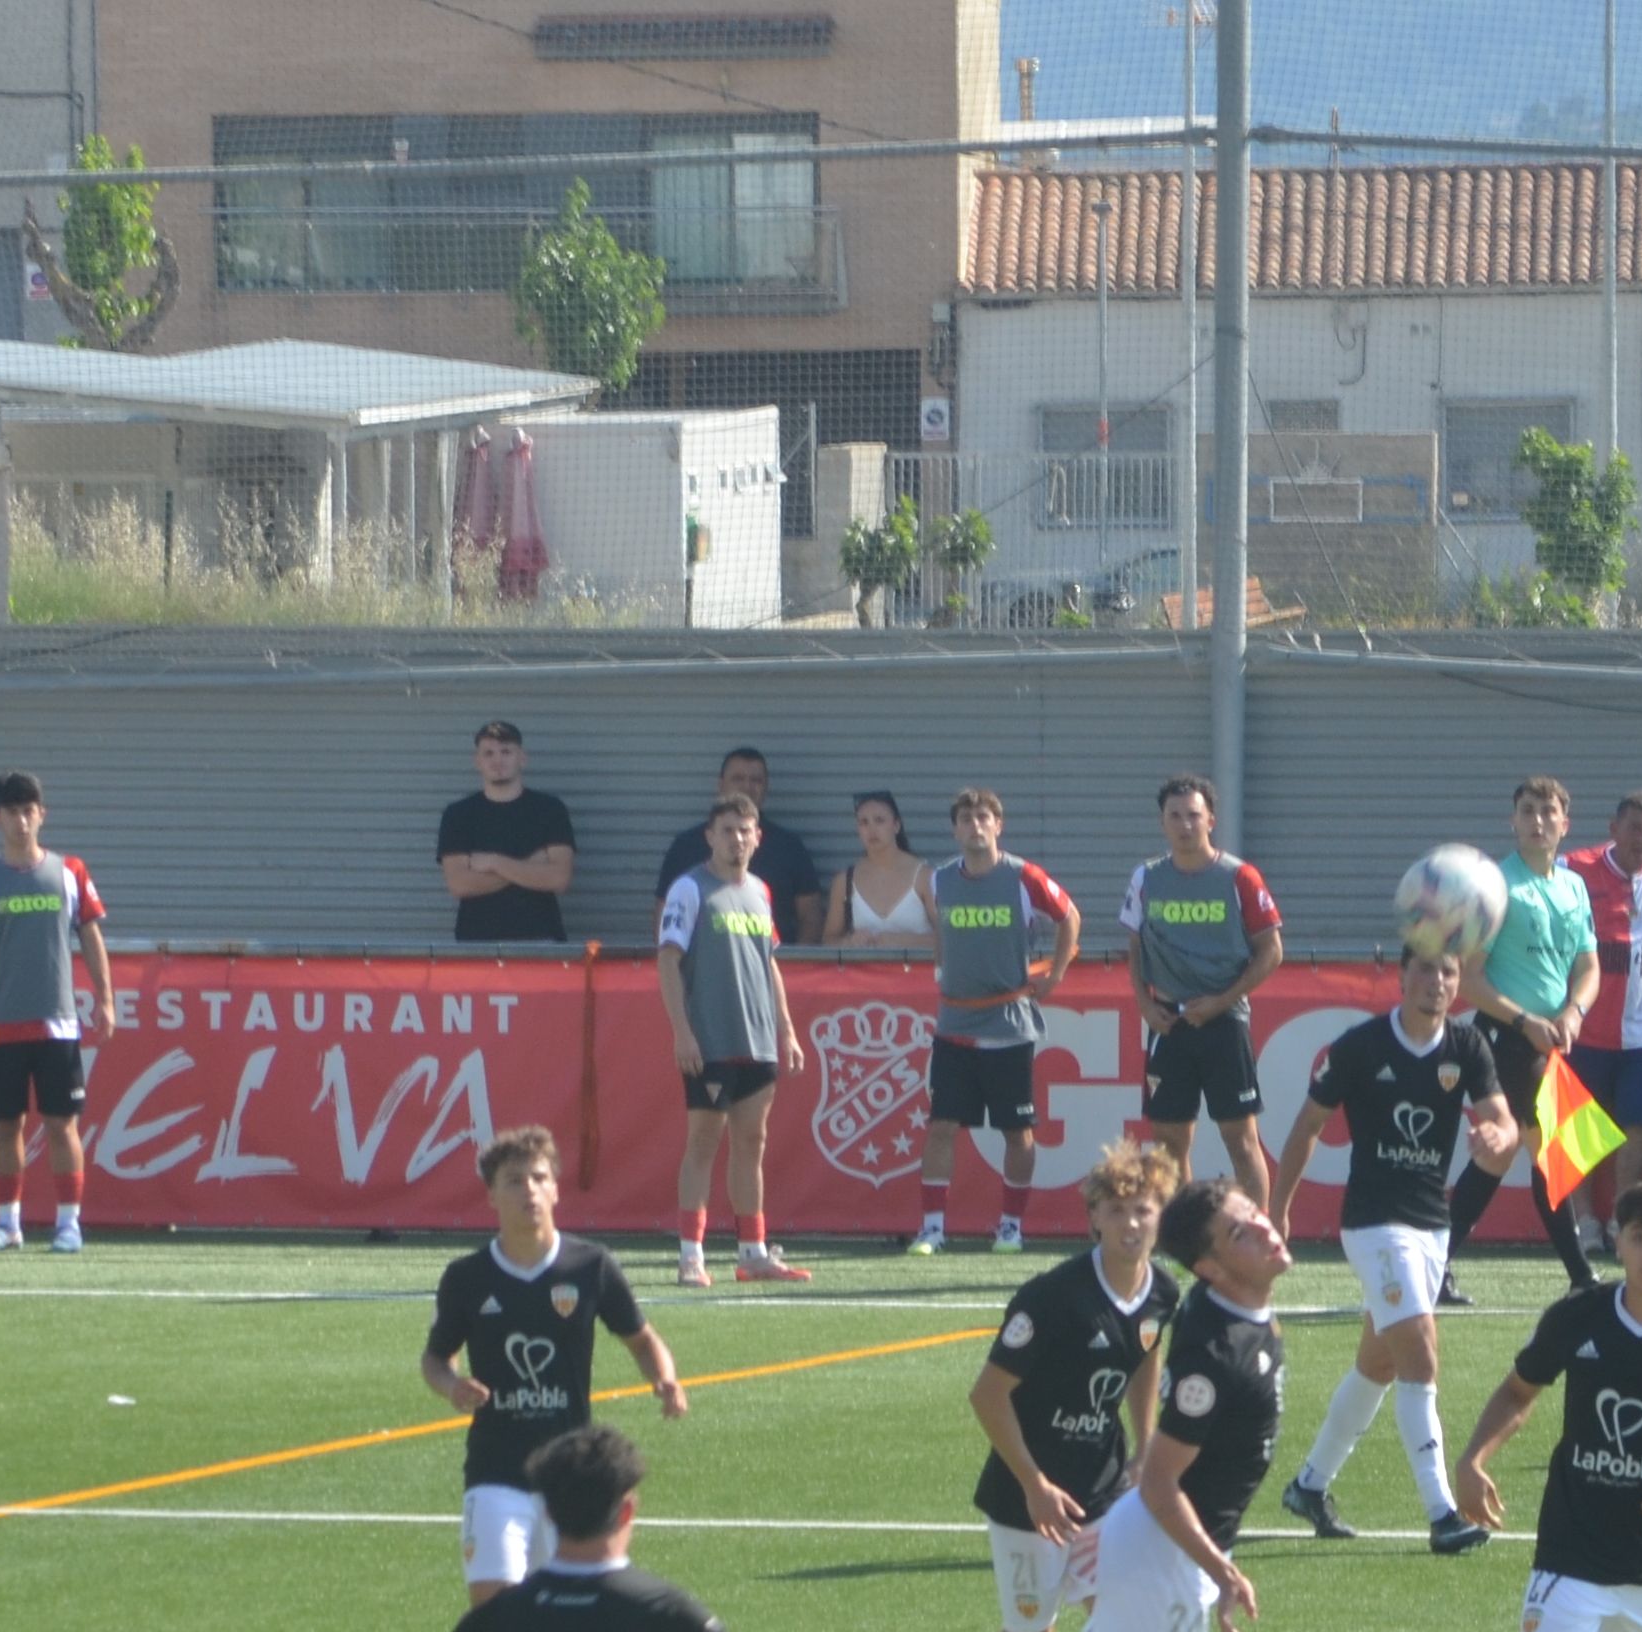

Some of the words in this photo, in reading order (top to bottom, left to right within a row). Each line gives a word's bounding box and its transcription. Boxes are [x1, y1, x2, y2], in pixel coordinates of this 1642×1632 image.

[950, 905, 1012, 928] GIOS
[1163, 901, 1226, 923] GIOS
[828, 1057, 920, 1139] GIOS
[493, 1385, 568, 1410] LaPobla
